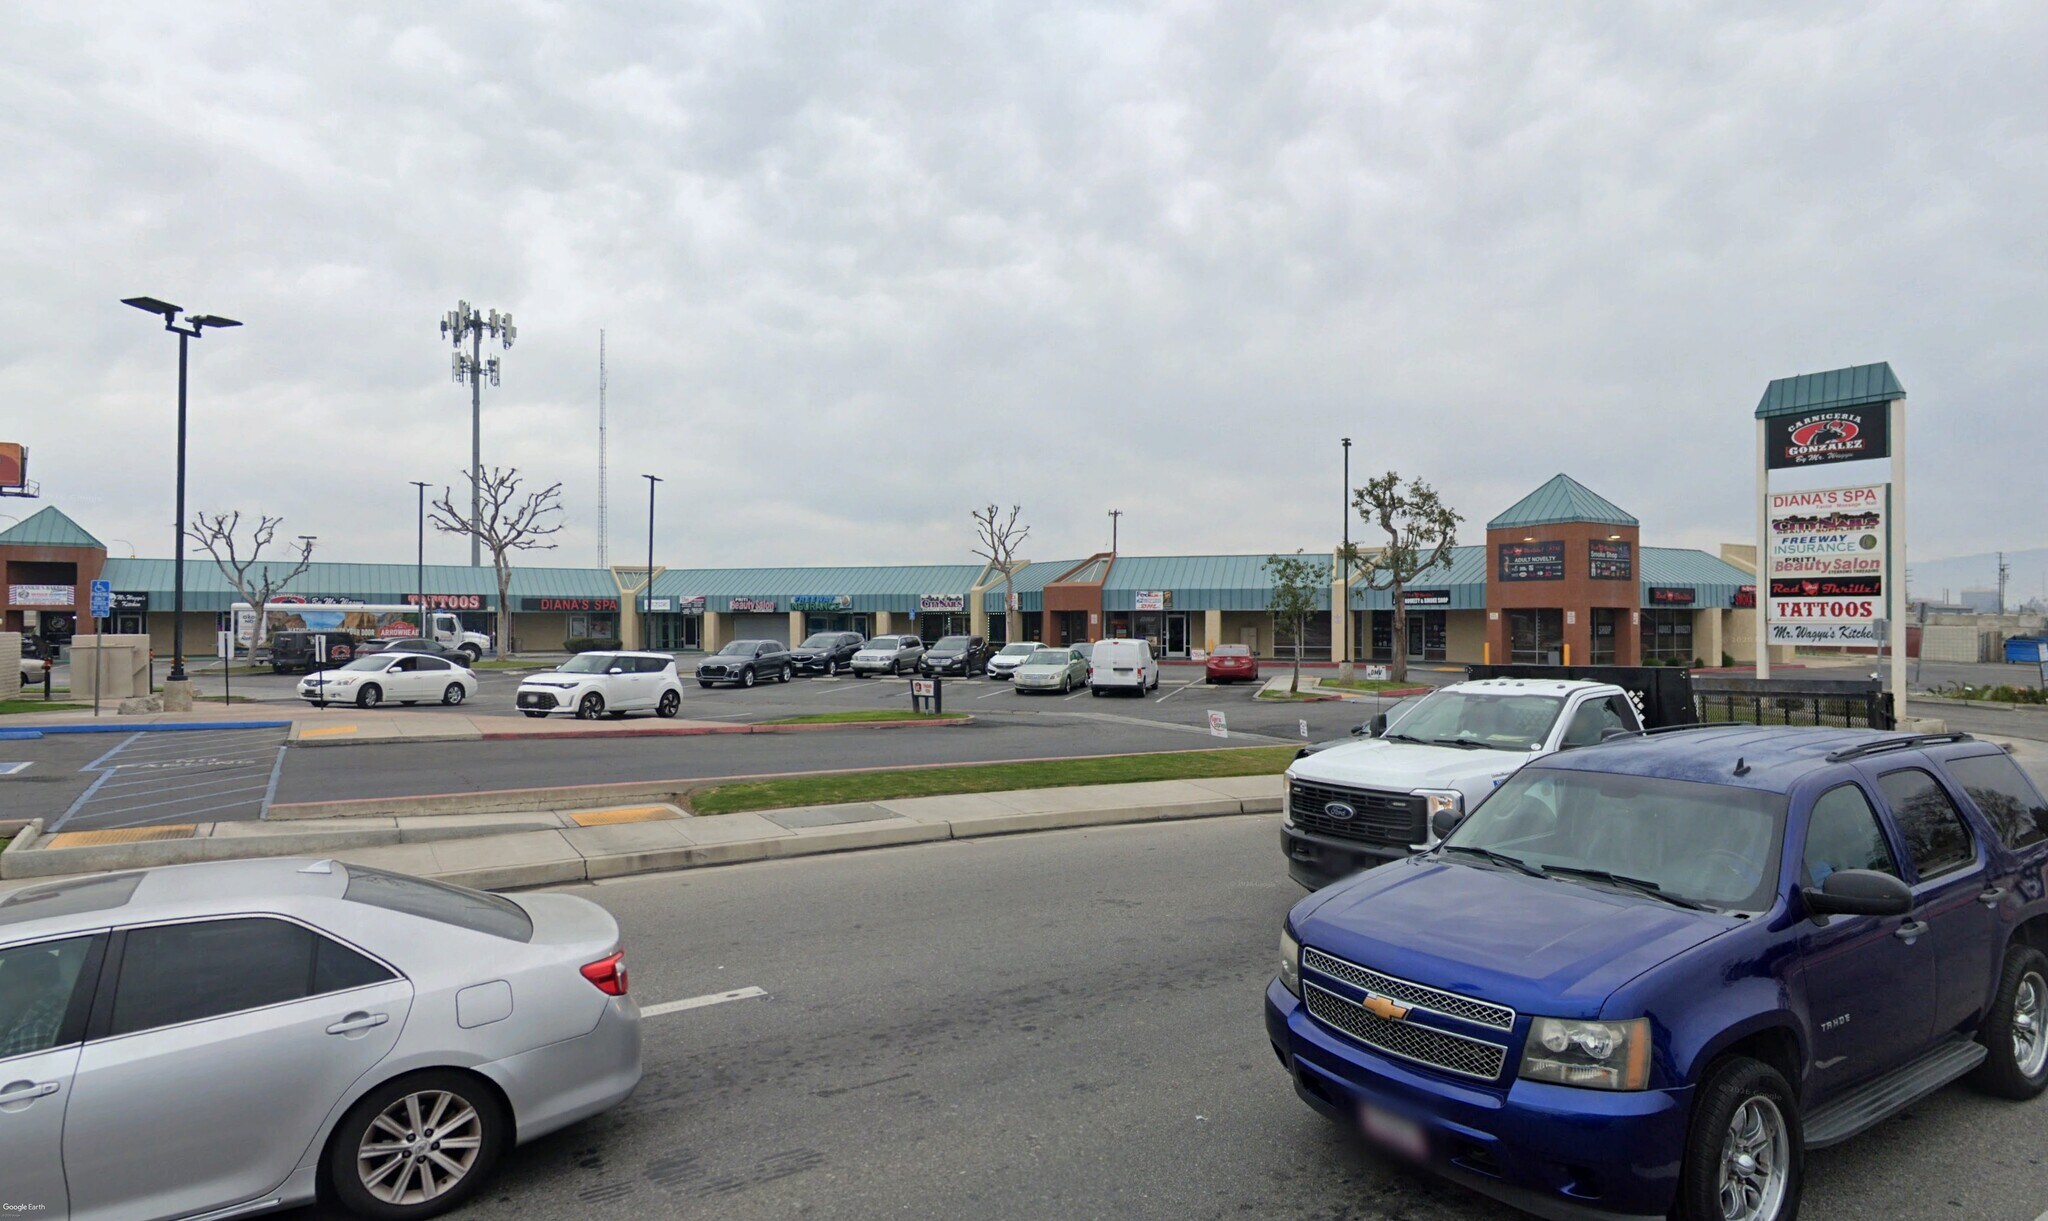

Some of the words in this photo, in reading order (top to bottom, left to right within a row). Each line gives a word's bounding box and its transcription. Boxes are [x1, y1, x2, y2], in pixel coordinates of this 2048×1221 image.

[1787, 412, 1862, 432] CARNICERIA
[1788, 439, 1863, 456] GONZALEZ
[1795, 455, 1806, 463] By
[1808, 453, 1825, 461] Mr.
[1773, 491, 1838, 508] DIANA'S
[1843, 489, 1876, 503] SPA
[1782, 534, 1848, 545] FREEWAY
[1774, 542, 1856, 555] INSURANCE
[1531, 555, 1557, 563] NOVELTY
[1775, 559, 1831, 573] Beauty
[1833, 557, 1881, 570] Salon
[1772, 583, 1800, 593] Red
[407, 594, 480, 610] TATTOOS
[540, 597, 589, 611] DIANA'S
[594, 598, 618, 611] SPA
[754, 600, 775, 610] Salon
[1777, 601, 1873, 618] TATTOOS
[1773, 625, 1794, 639] Mr.
[1794, 625, 1836, 643] Wagyu's
[1838, 625, 1874, 640] Kitche
